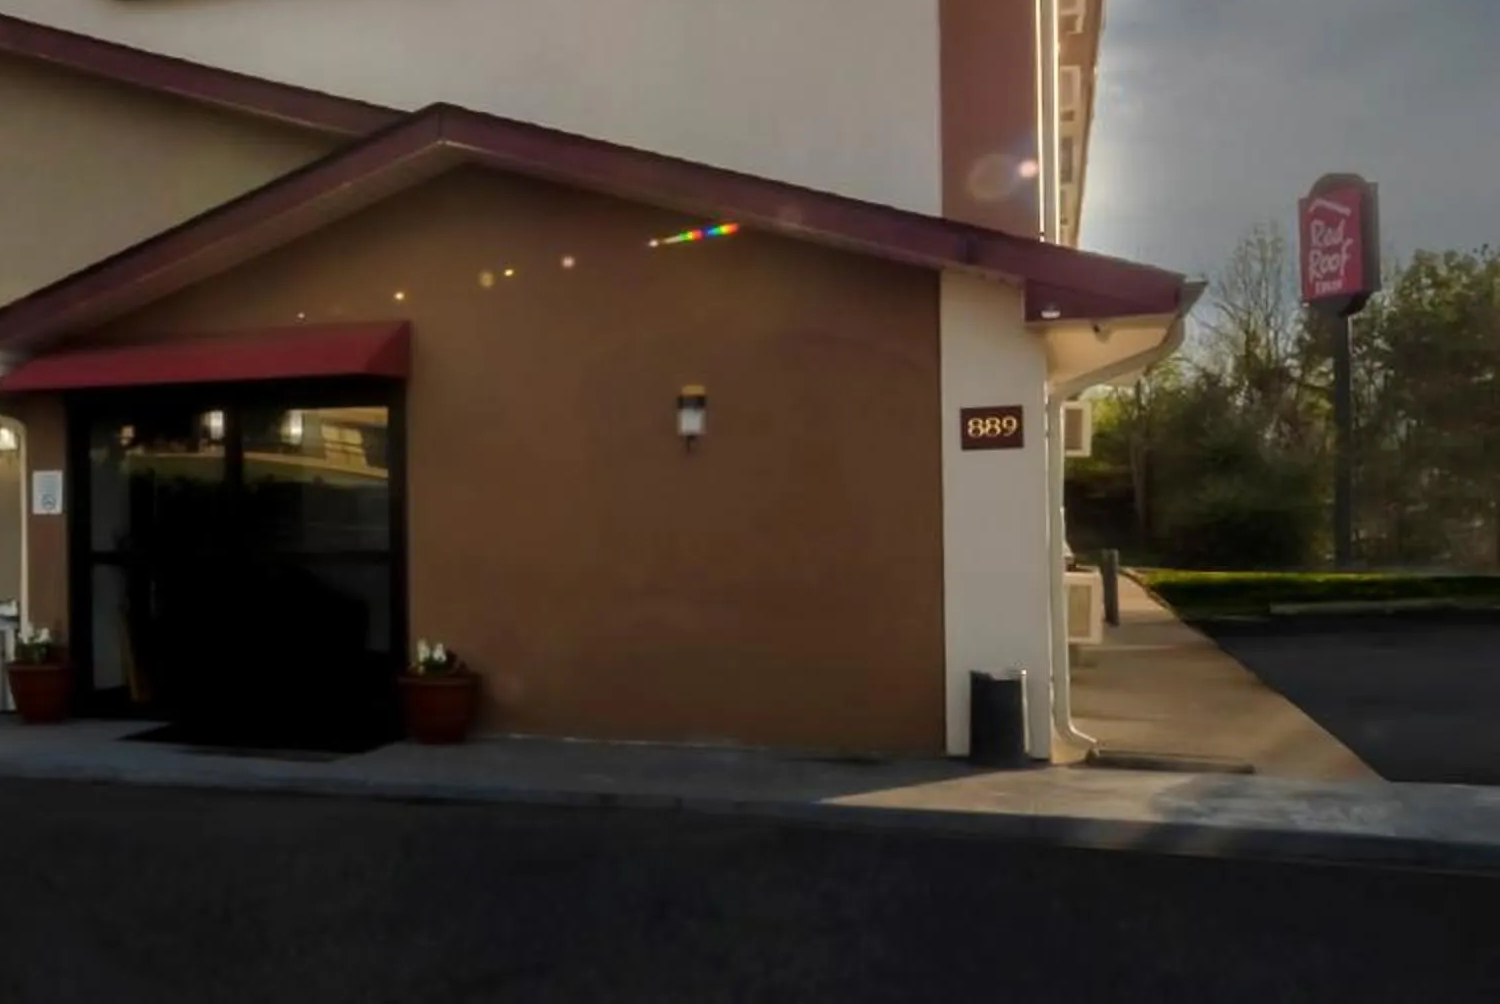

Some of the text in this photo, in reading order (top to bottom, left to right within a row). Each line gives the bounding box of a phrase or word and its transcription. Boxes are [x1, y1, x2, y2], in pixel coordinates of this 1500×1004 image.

[1310, 218, 1346, 246] Red
[1309, 238, 1354, 283] Roof
[967, 416, 1018, 438] 889
